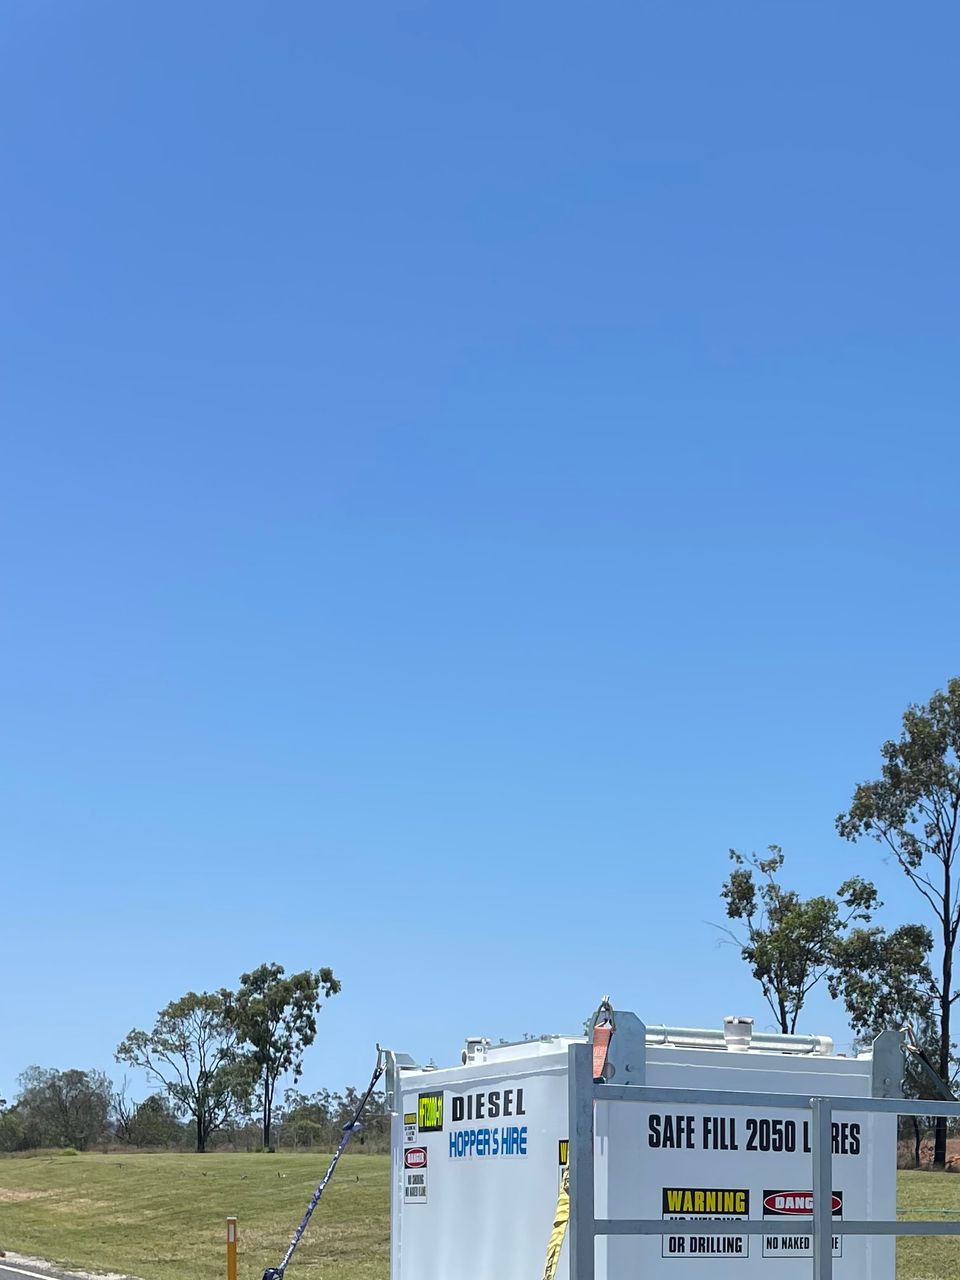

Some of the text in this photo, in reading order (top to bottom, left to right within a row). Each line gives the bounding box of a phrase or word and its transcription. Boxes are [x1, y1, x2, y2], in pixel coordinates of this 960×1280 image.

[452, 1088, 525, 1121] DIESEL
[449, 1127, 499, 1157] HOPPER'S
[501, 1126, 528, 1155] HIRE
[649, 1114, 861, 1155] SAFE FILL 2050 LRES
[667, 1190, 746, 1212] WARNING
[775, 1196, 814, 1209] DANG
[669, 1236, 743, 1253] OR DRILLING
[766, 1236, 810, 1250] NO NAKED
